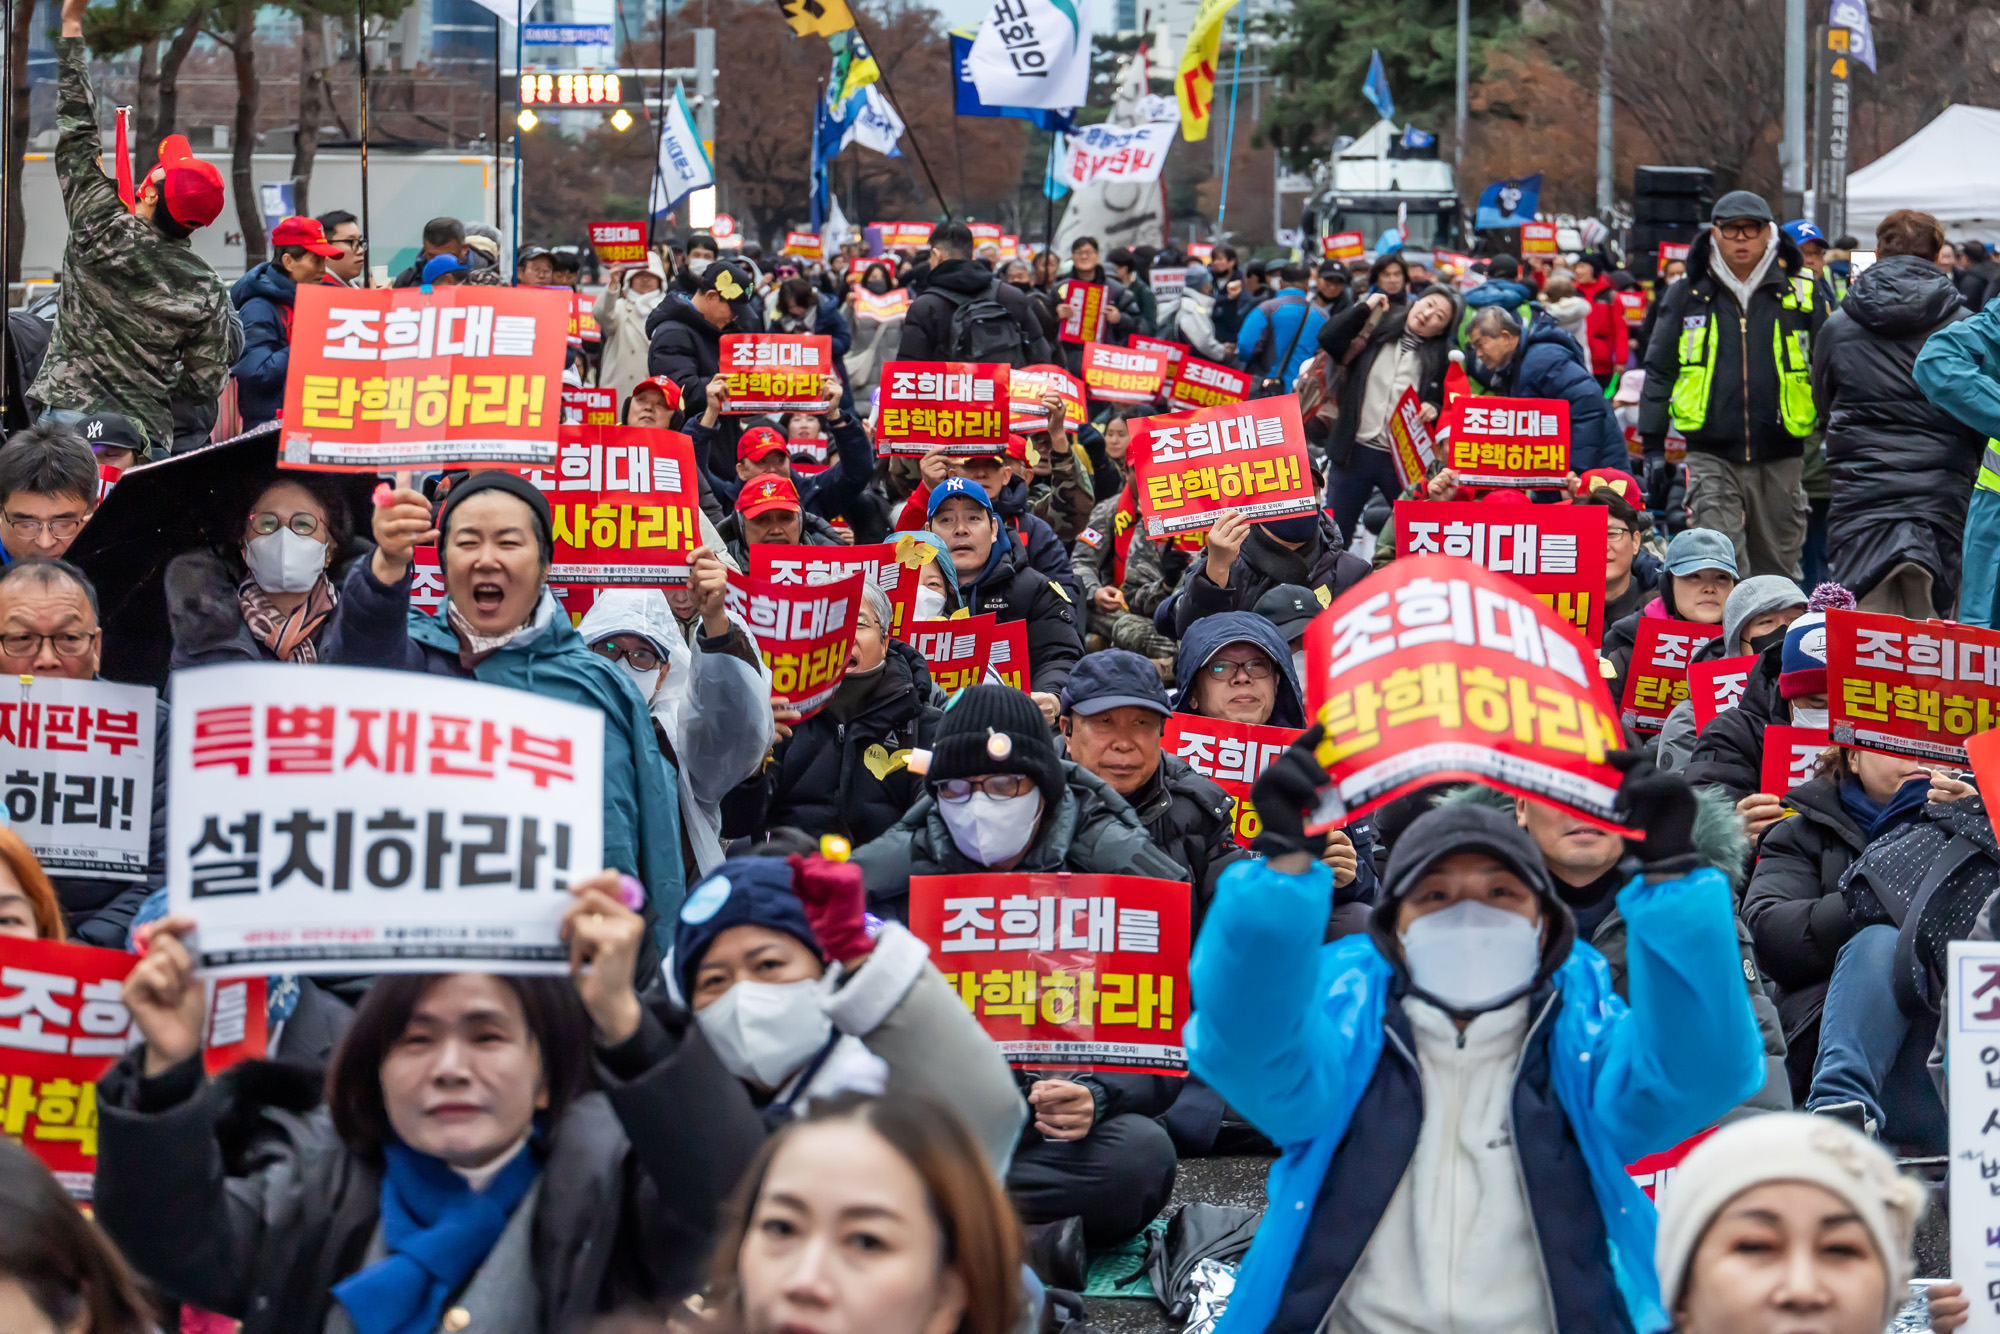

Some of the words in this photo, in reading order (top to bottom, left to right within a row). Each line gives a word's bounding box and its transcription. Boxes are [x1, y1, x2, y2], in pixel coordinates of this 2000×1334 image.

[1830, 58, 1848, 79] 4
[322, 305, 537, 361] 조희대를
[731, 343, 820, 366] 조희대를
[1091, 345, 1161, 373] 조희대를
[301, 374, 546, 430] 탄핵하라!
[890, 371, 995, 403] 조희대를
[1085, 368, 1160, 391] 탄핵하라!
[1183, 362, 1243, 394] 조희대를
[86, 420, 104, 439] NY
[883, 407, 1002, 438] 탄핵하라!
[1149, 414, 1285, 464] 조희대를
[1462, 407, 1559, 437] 조희대를
[1454, 441, 1565, 471] 탄핵하라!
[944, 475, 966, 493] NY
[1146, 454, 1302, 511] 탄핵하라!
[1408, 520, 1578, 575] 조희대를
[724, 584, 848, 641] 조희대를
[1328, 578, 1589, 689] 조희대를
[909, 628, 978, 664] 대를
[1855, 628, 2000, 687] 조희대
[1315, 663, 1618, 769] 탄핵하라!
[193, 706, 575, 788] 특별재판부
[7, 769, 135, 831] 하라!
[189, 809, 571, 898] 설치하라!
[940, 894, 1160, 954] 조희대를
[0, 966, 248, 1057] 조희를
